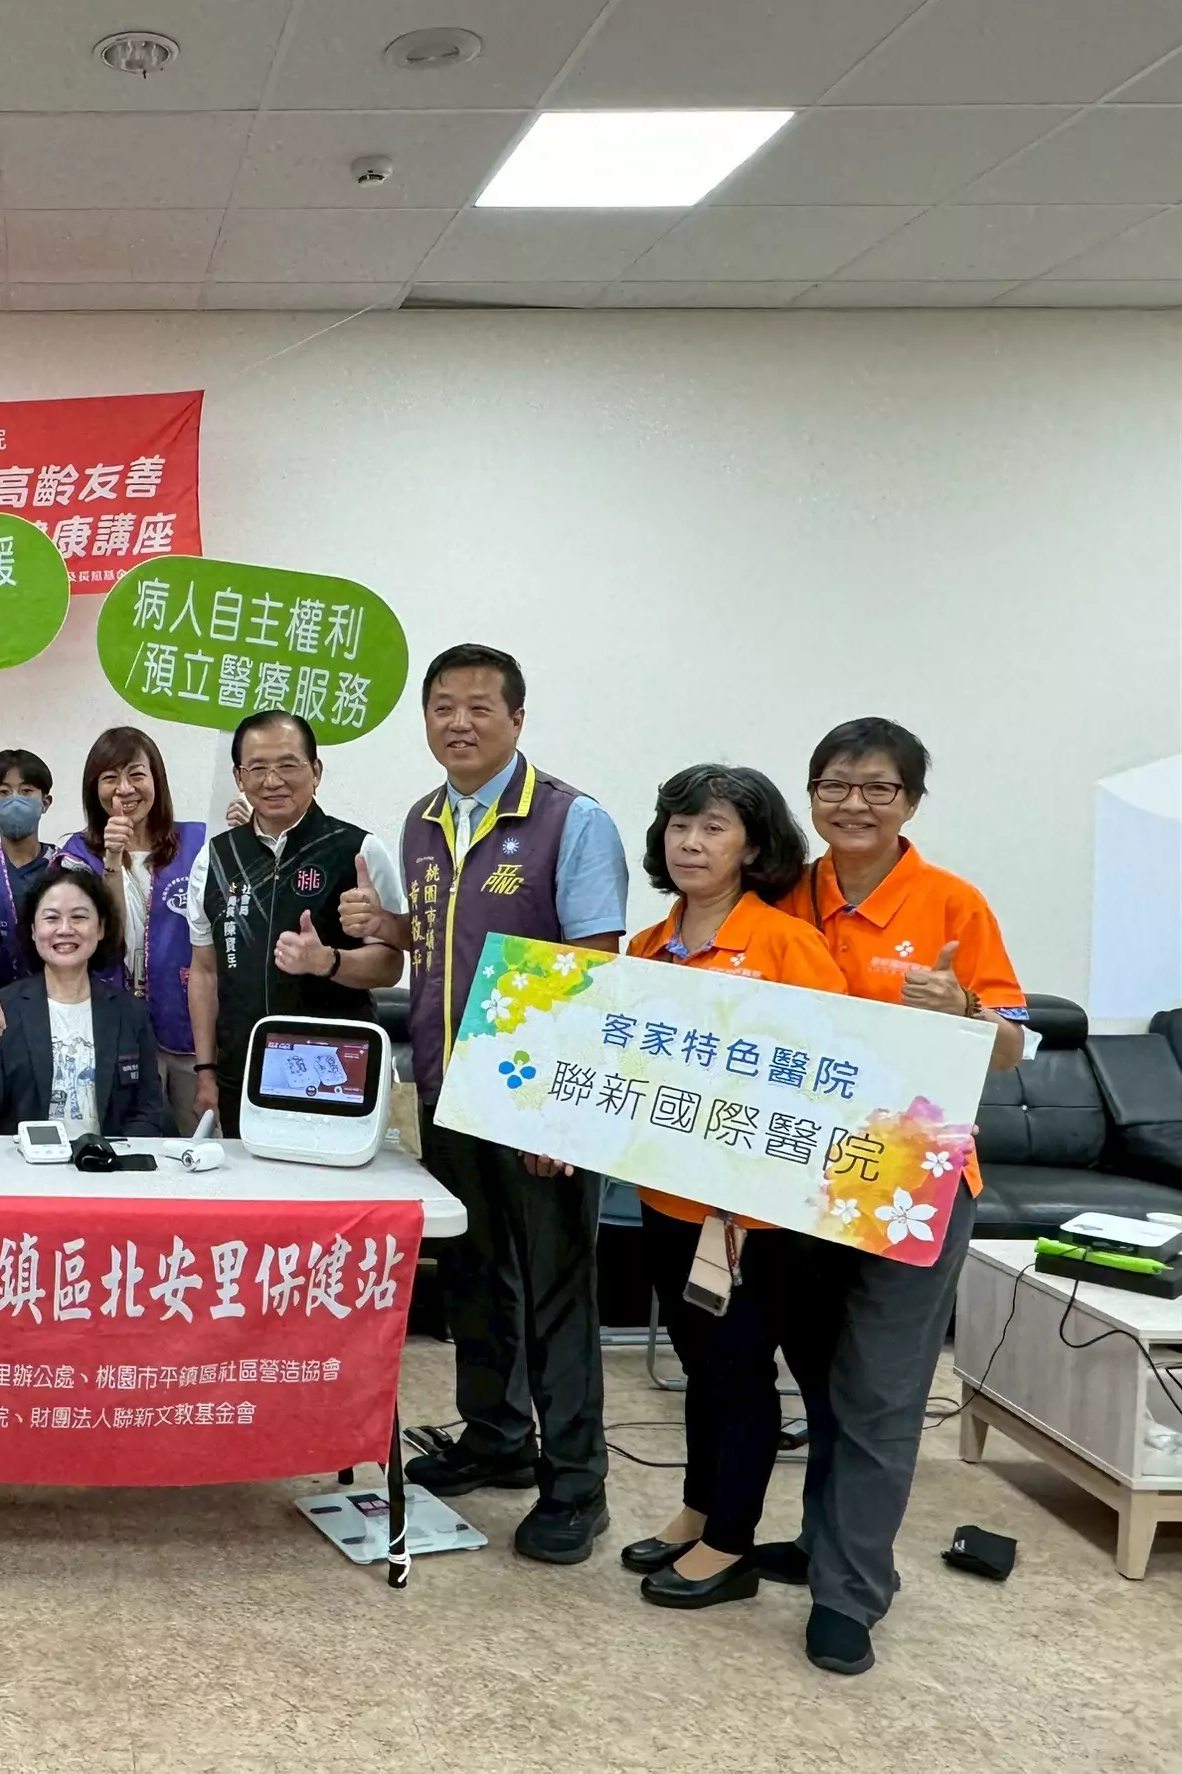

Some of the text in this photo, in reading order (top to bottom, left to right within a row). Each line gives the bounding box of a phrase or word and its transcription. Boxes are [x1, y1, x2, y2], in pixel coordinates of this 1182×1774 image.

[34, 512, 177, 559] 康講座
[133, 579, 365, 662] 病人自主權利
[124, 641, 373, 729] /預立醫療服務
[600, 1012, 860, 1101] 客家特色醫院
[547, 1059, 886, 1183] 聯新國際醫院
